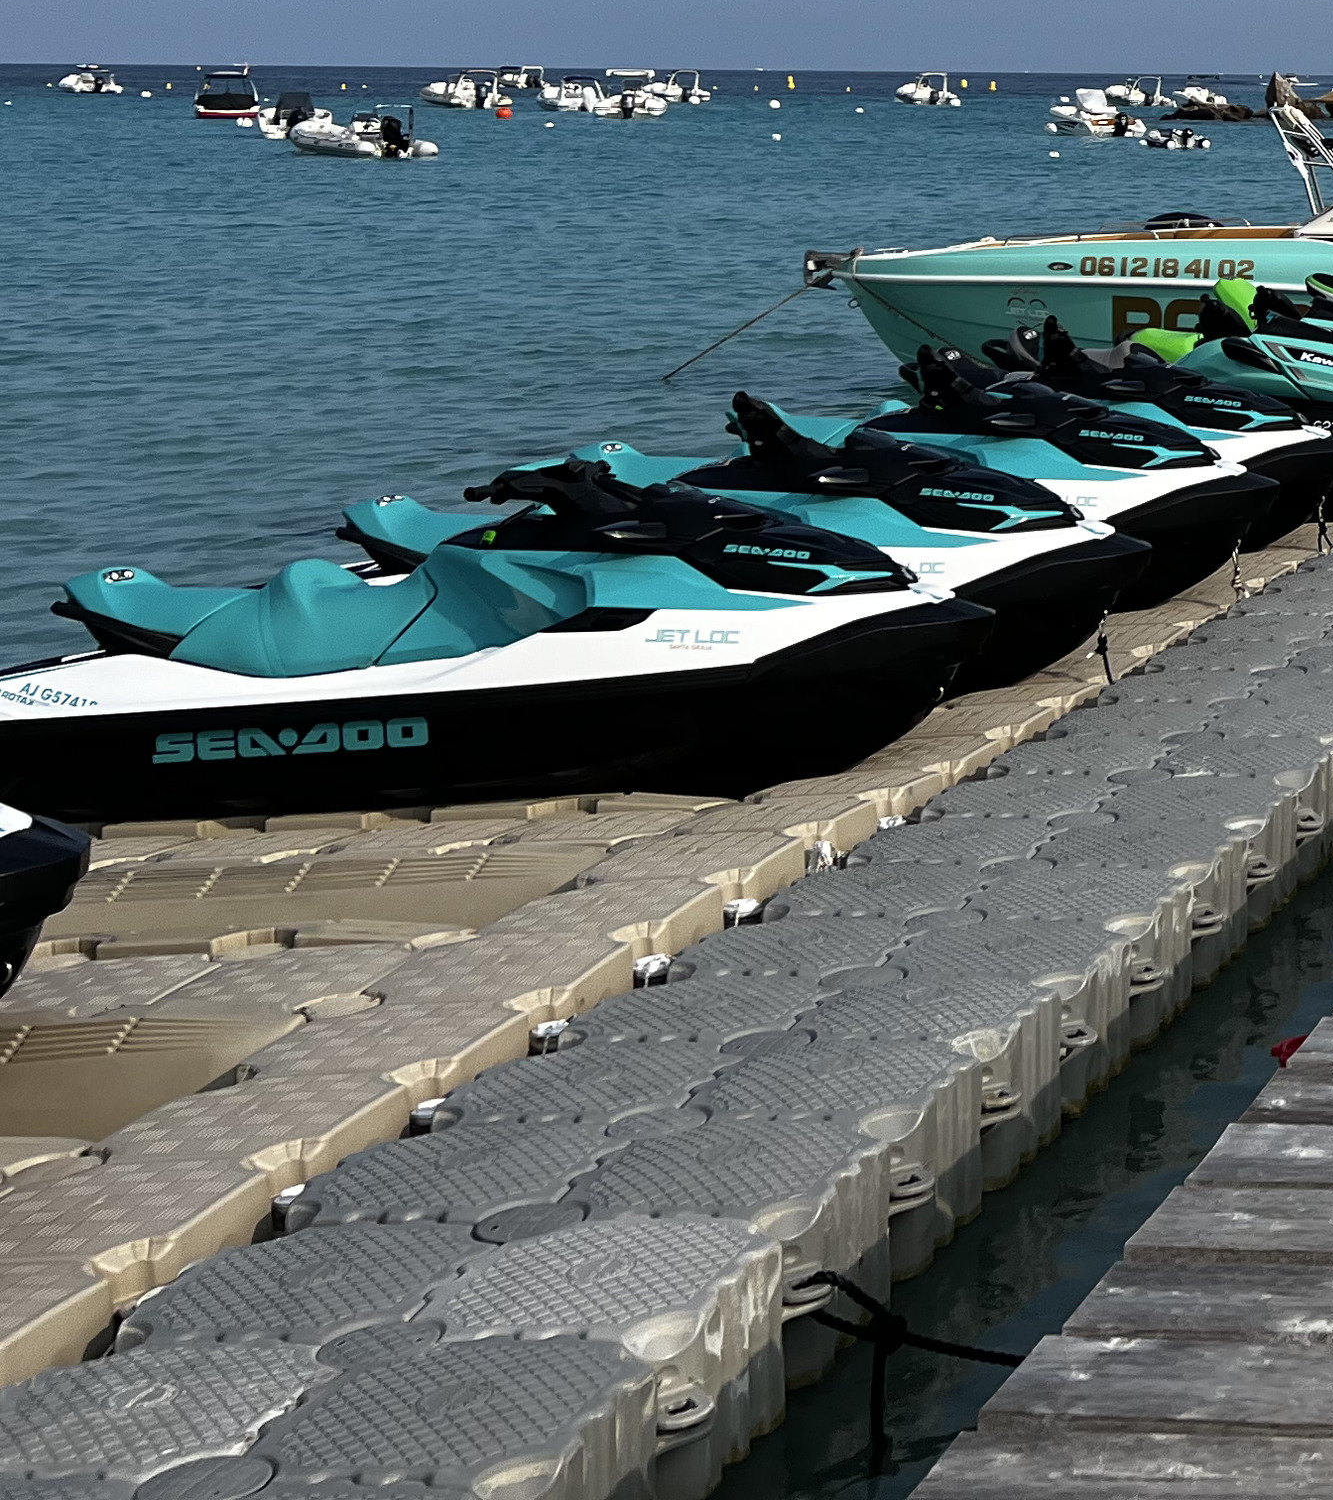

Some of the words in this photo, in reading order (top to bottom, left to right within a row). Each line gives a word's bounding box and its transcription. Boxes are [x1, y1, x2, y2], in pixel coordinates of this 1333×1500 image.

[1079, 256, 1115, 277] 06
[1120, 257, 1149, 278] 12
[1153, 257, 1179, 278] 18
[1184, 258, 1211, 279] 41
[1217, 259, 1256, 280] 02
[645, 630, 690, 643] JET
[695, 630, 740, 644] LOC
[19, 683, 40, 696] AJ
